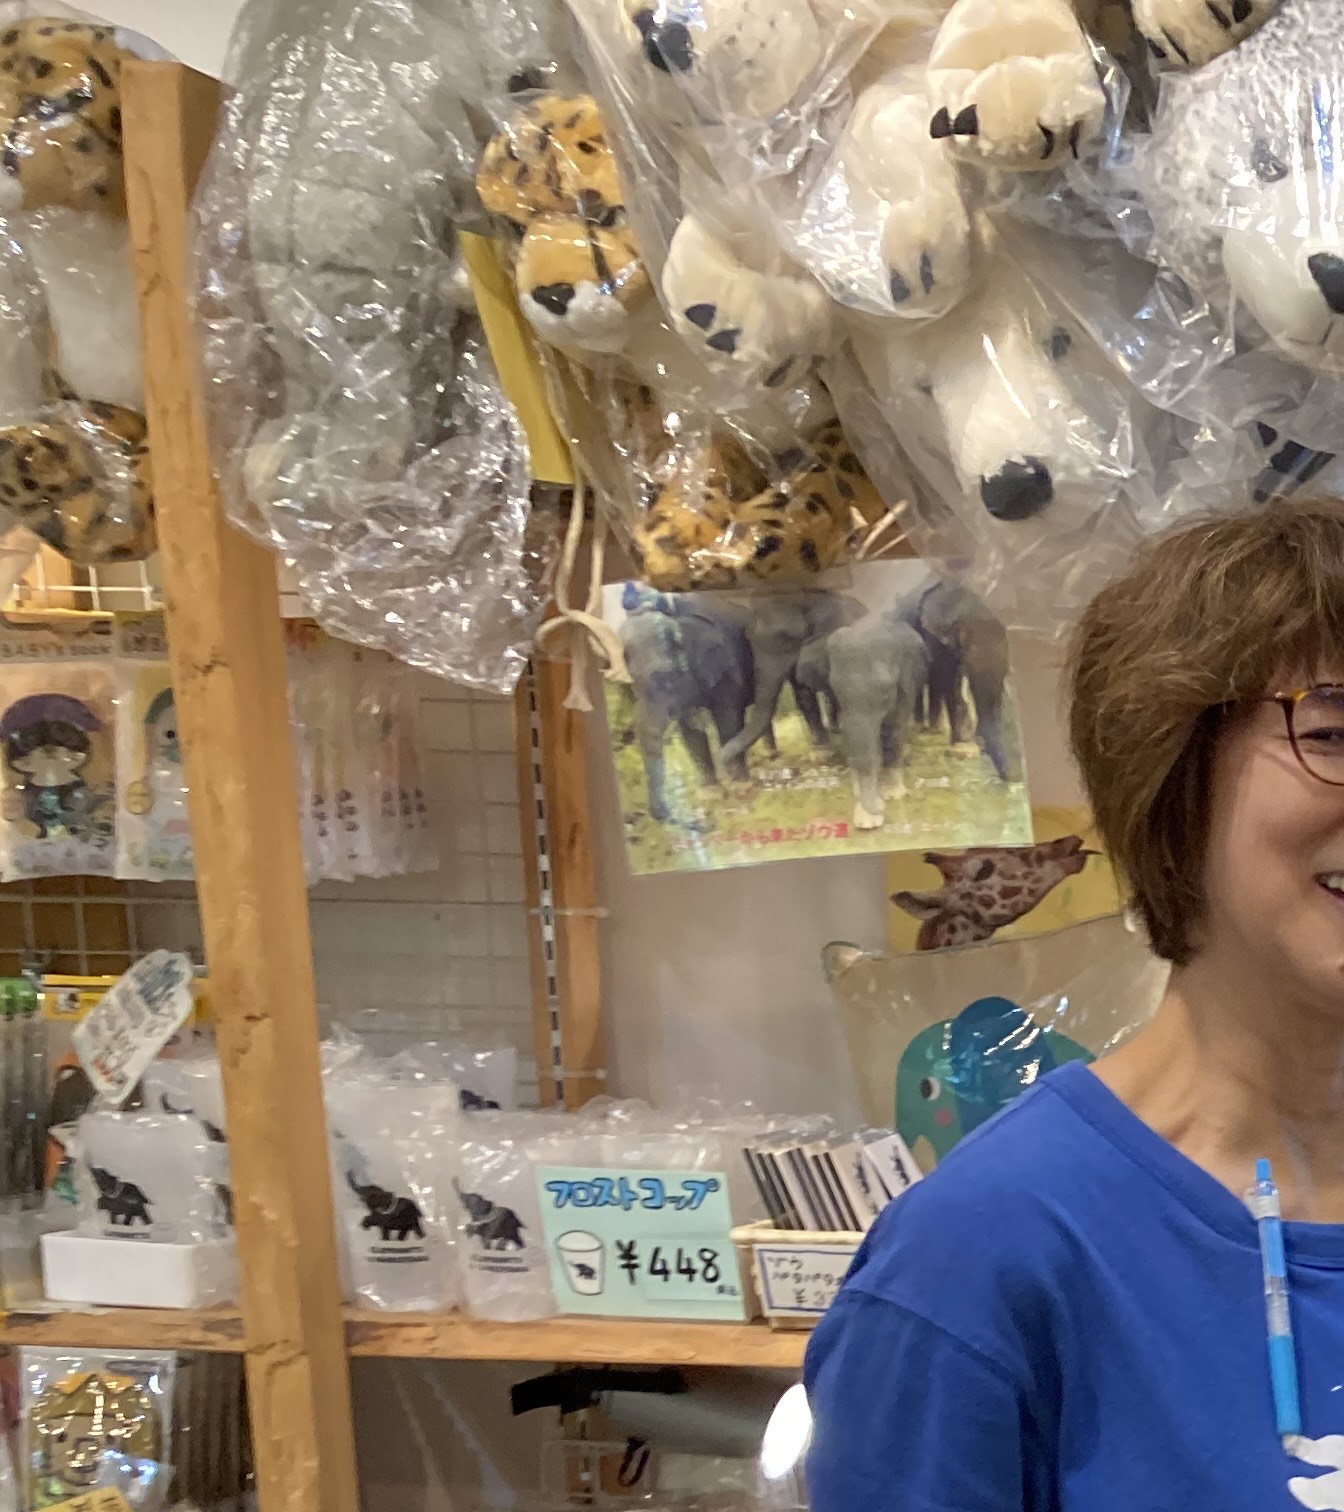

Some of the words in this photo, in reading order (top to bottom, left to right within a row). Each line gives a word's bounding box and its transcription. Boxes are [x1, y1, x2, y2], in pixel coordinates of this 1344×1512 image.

[545, 1177, 719, 1210] フロストコップ
[614, 1239, 720, 1285] ¥448
